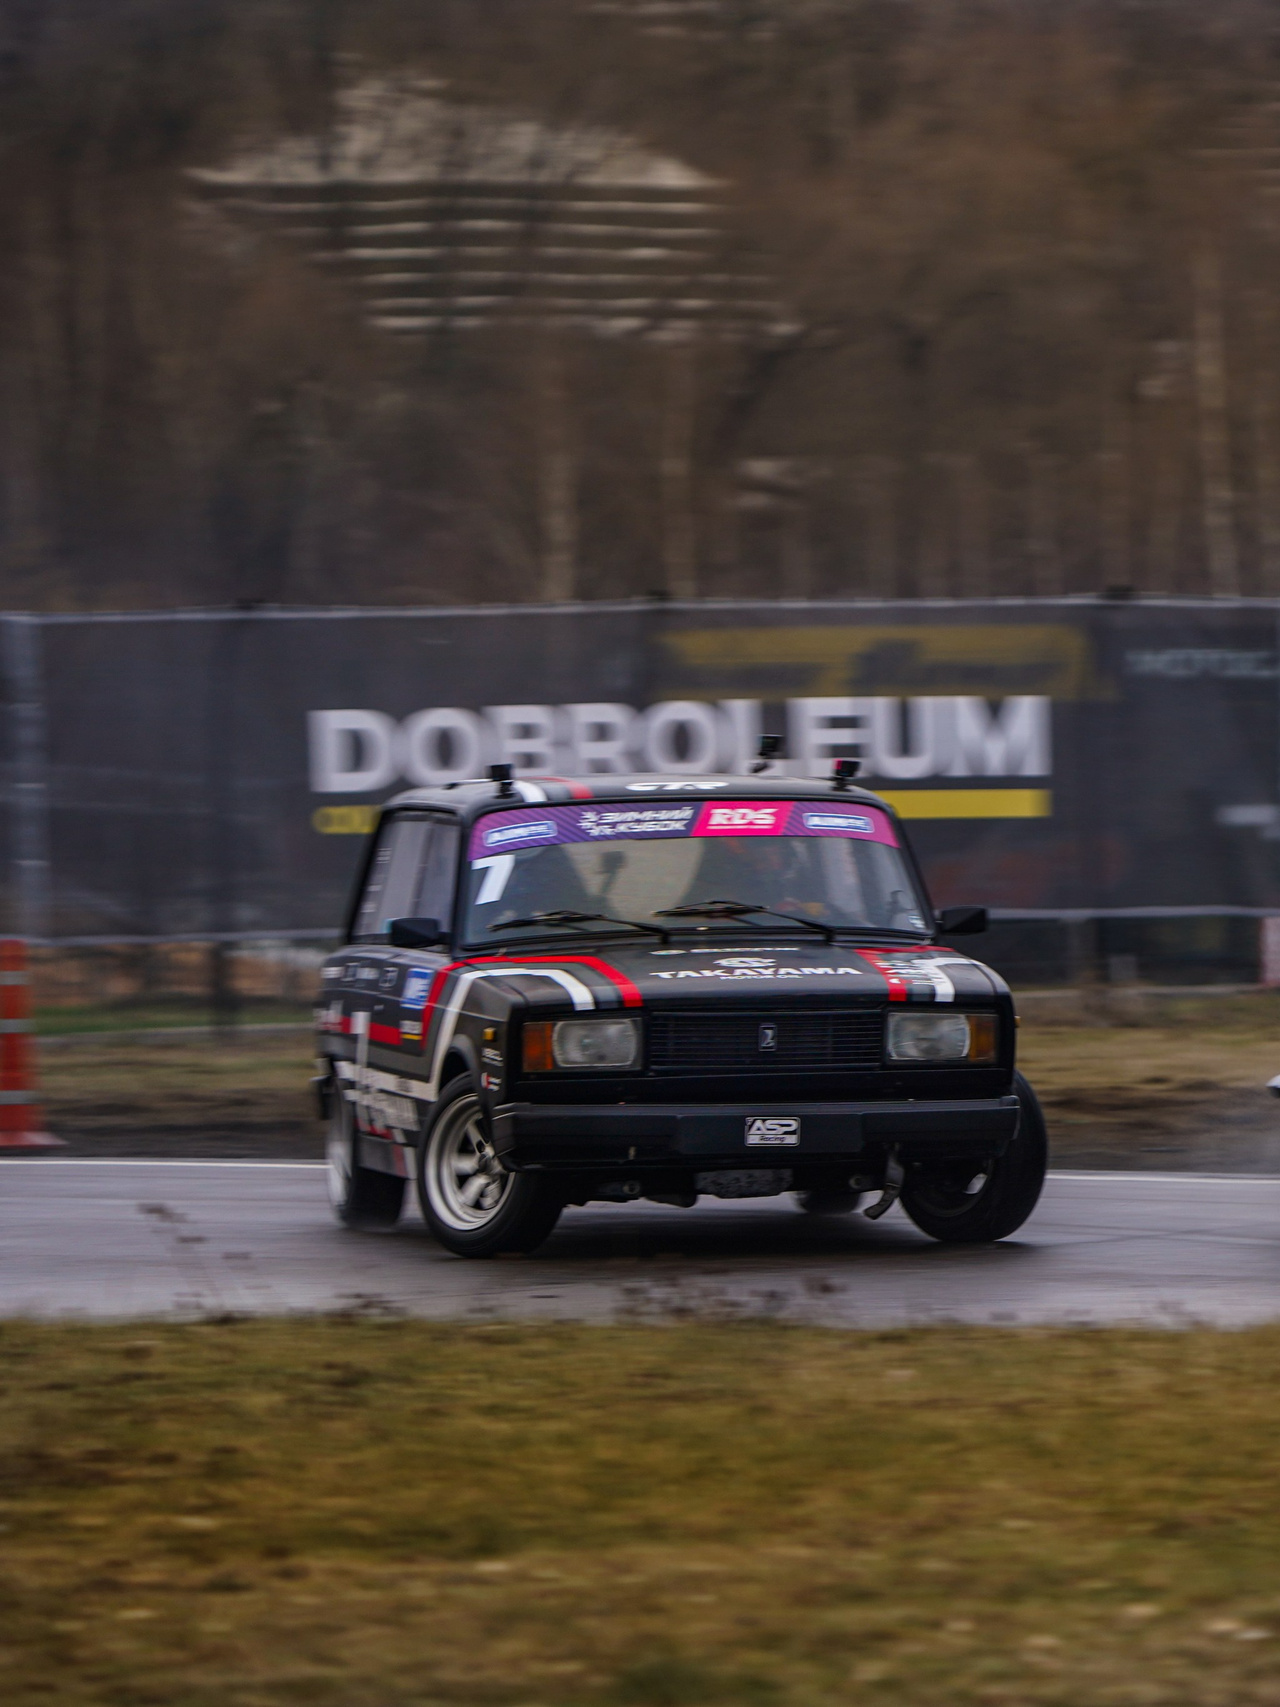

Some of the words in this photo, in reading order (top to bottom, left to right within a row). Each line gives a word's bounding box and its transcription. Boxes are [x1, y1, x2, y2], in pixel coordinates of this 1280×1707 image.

[307, 695, 1051, 793] DOBROLEUM
[707, 808, 779, 825] RDS
[649, 967, 864, 979] TAKAYAMA
[747, 1119, 799, 1135] ASP
